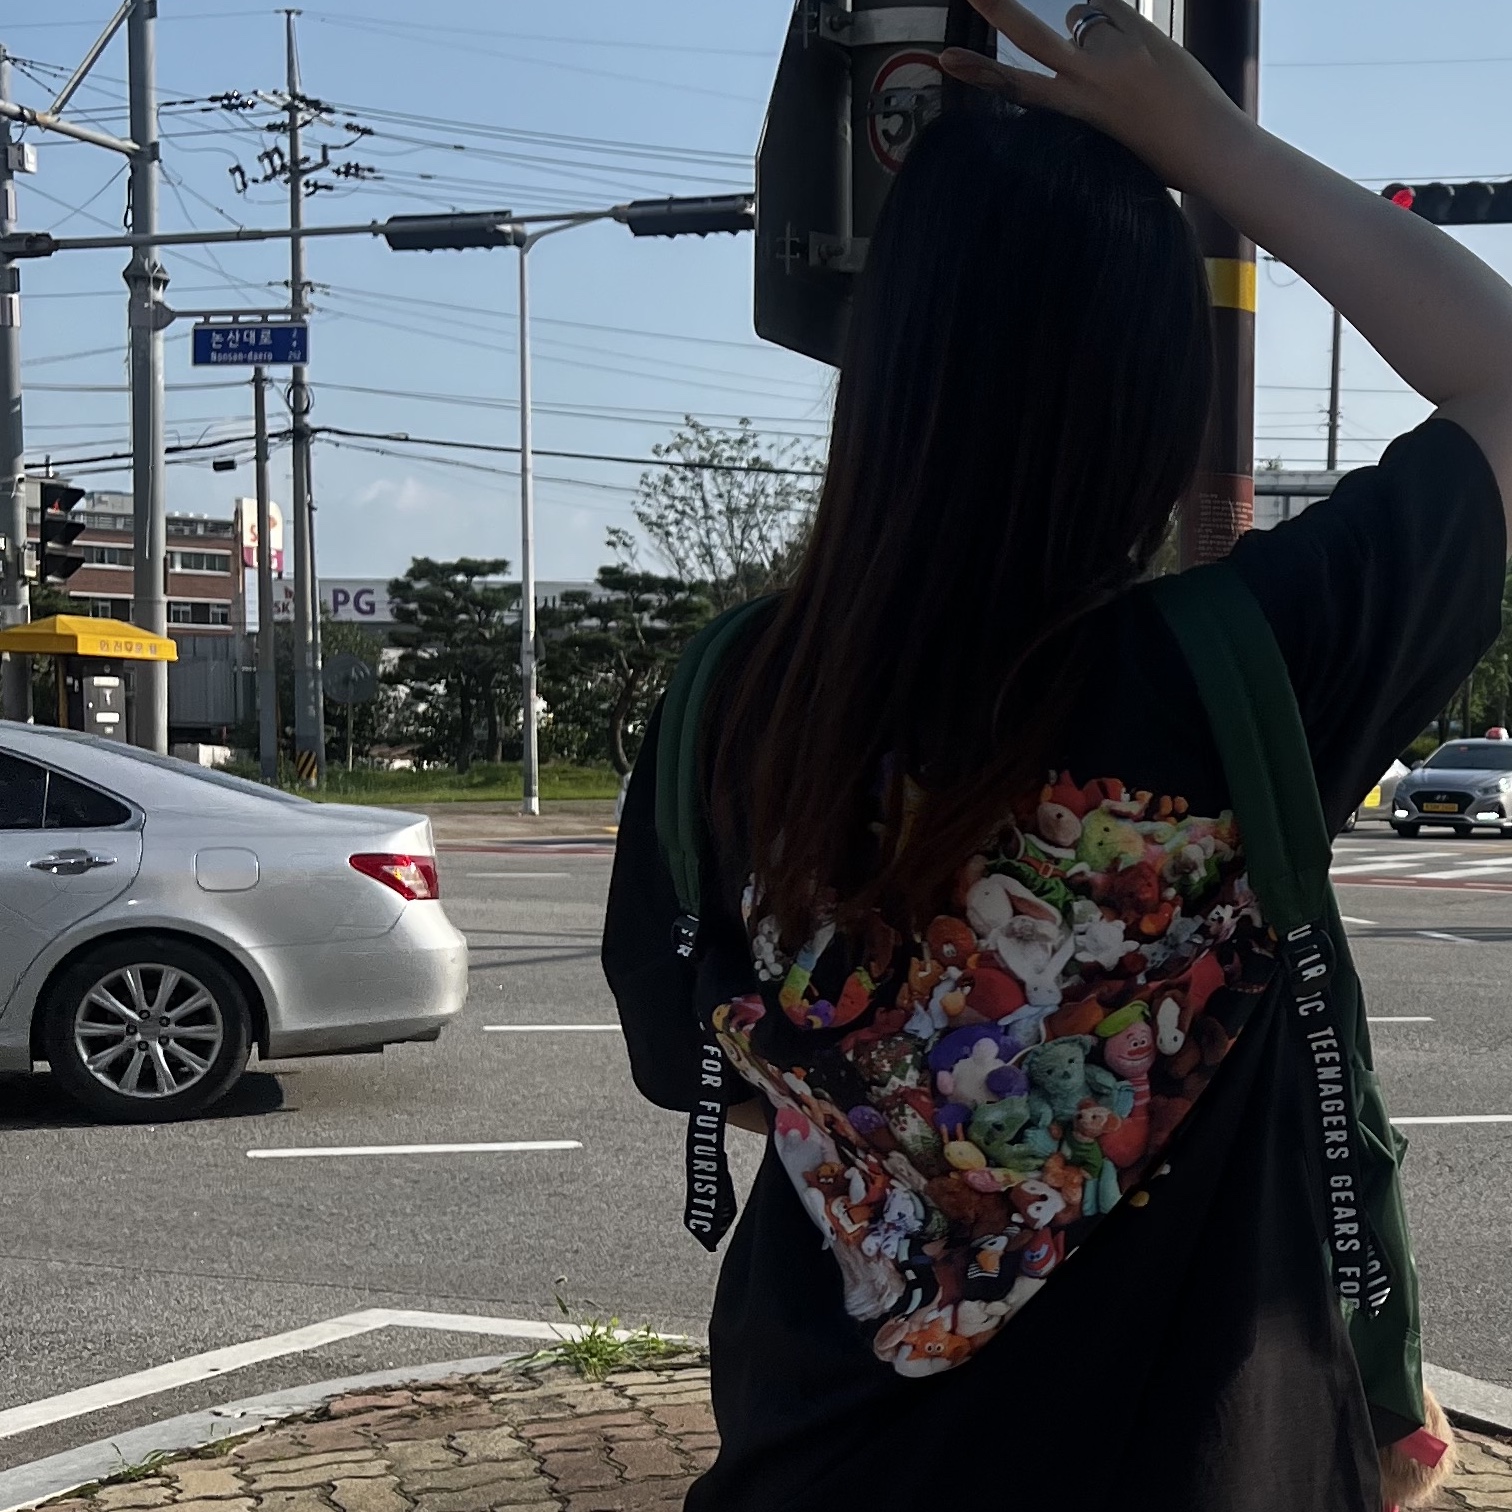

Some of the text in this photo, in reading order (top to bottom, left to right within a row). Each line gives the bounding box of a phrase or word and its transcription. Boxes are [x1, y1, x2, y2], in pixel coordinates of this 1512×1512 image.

[210, 350, 273, 362] Nonsan-daero
[211, 328, 273, 349] 논산대로
[688, 1044, 723, 1234] FOR FUTURISTIC
[1306, 1025, 1350, 1160] TEENAGERS
[1329, 1174, 1361, 1252] GEARS
